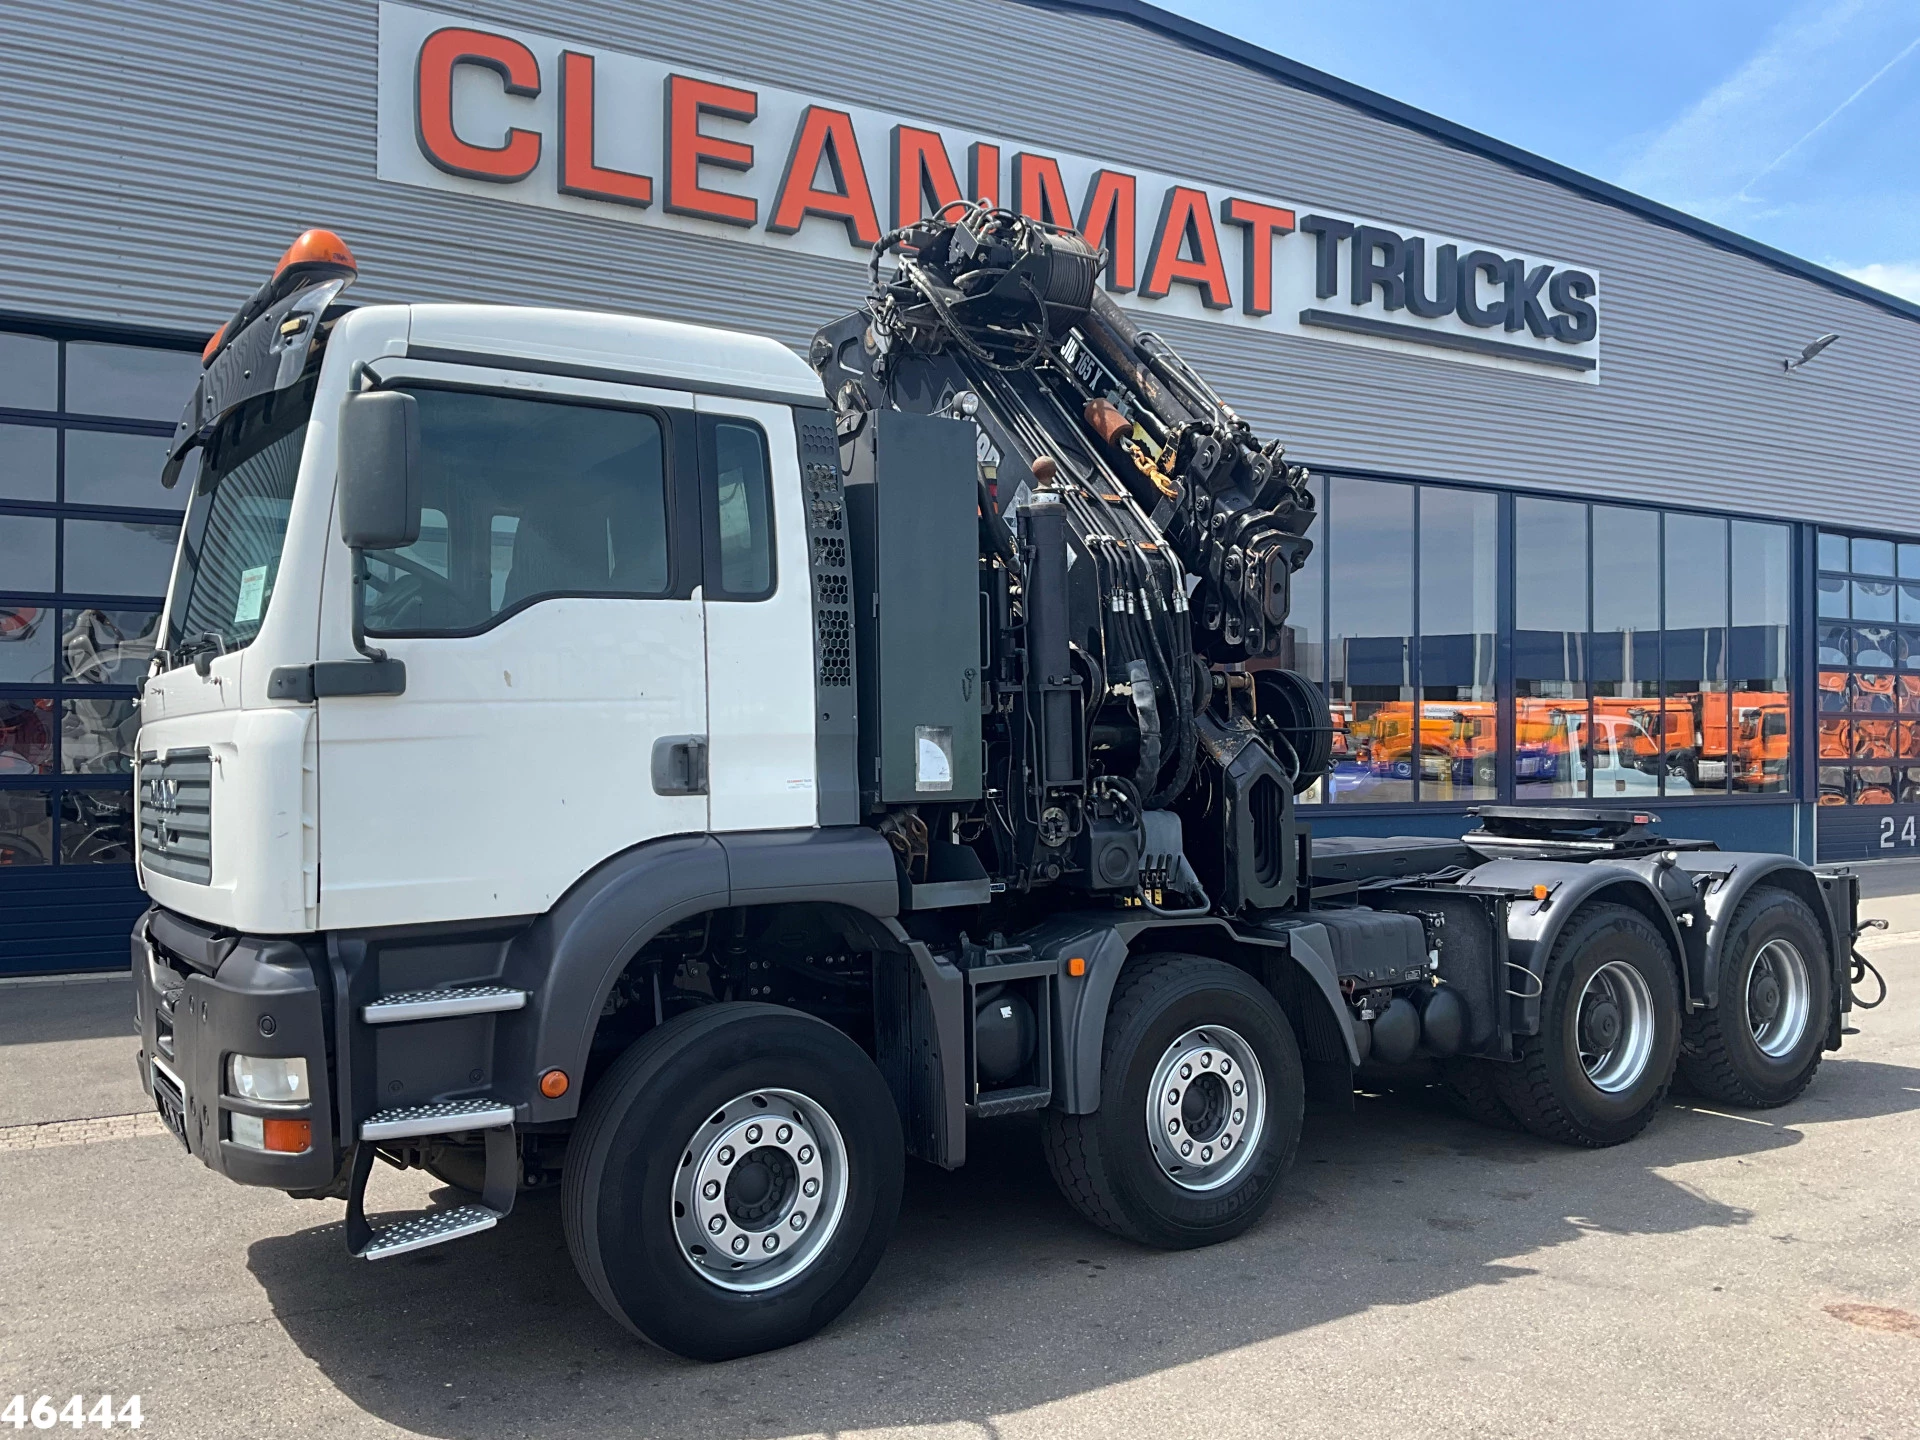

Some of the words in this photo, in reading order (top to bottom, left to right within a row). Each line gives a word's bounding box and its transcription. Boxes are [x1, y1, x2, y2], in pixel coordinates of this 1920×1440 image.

[416, 26, 1295, 317] CLEANMAT
[1300, 213, 1598, 345] TRUCKS
[1075, 352, 1095, 380] 165
[1880, 815, 1917, 848] 24
